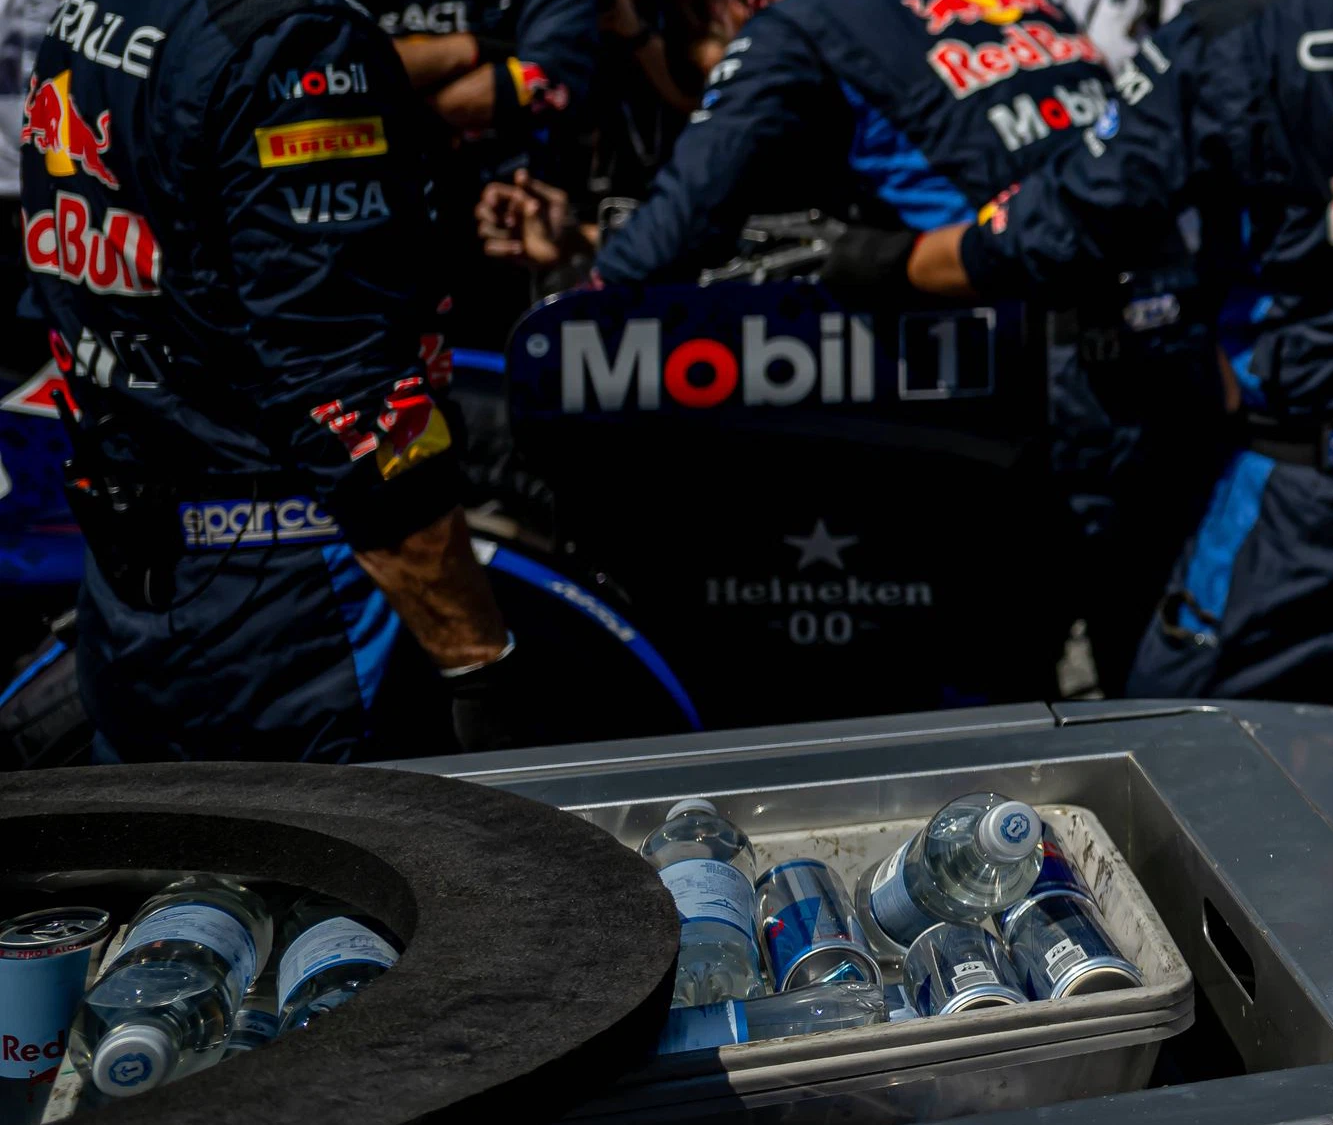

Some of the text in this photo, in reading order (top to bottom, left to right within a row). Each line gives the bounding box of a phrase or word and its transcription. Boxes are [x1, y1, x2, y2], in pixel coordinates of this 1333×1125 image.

[267, 61, 369, 102] Mobil
[269, 125, 375, 157] PIRELLI
[275, 179, 392, 224] VISA
[561, 312, 877, 414] Mobil
[182, 499, 340, 546] sparco
[704, 574, 935, 607] Heineken
[2, 1030, 66, 1062] Red
